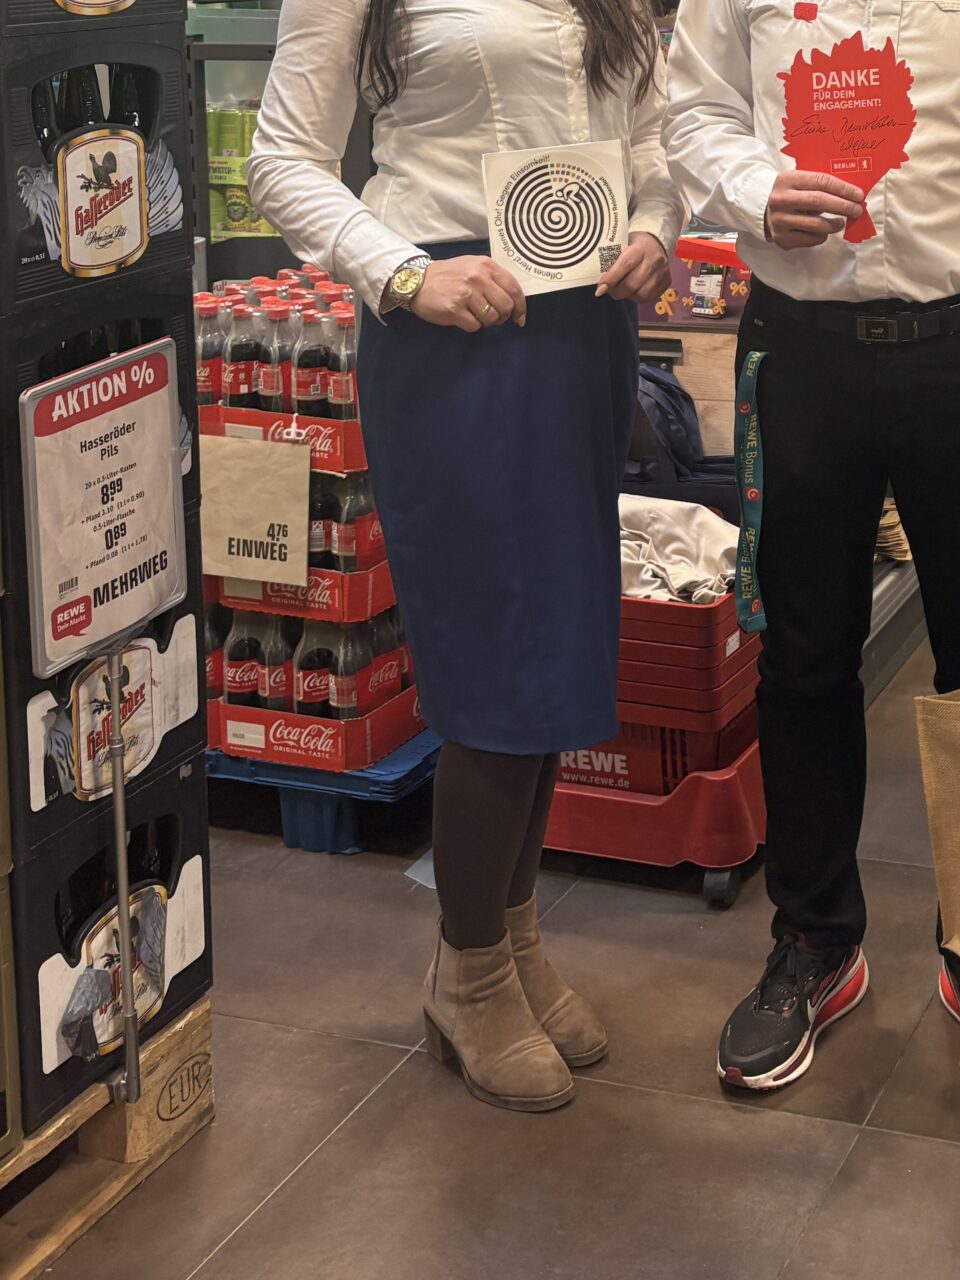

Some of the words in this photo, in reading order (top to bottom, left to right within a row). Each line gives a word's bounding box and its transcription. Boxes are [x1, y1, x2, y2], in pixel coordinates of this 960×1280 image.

[812, 68, 881, 90] DANKE
[813, 90, 832, 101] FÜR
[833, 89, 856, 100] DEIN
[814, 98, 882, 112] ENGAGEMENT!
[833, 162, 856, 170] BERLIN
[496, 180, 513, 207] Gegen
[510, 154, 551, 180] Einsamkeit!
[52, 369, 128, 422] AKTION
[131, 360, 155, 390] %
[80, 421, 136, 454] Hasseröder
[746, 414, 758, 449] REWE
[100, 443, 120, 461] Pils
[744, 452, 758, 484] Bonus
[86, 510, 101, 524] Pfand
[101, 505, 114, 518] 3.10
[227, 537, 288, 562] EINWEG
[90, 556, 106, 569] Pfand
[92, 550, 168, 608] MEHRWEG
[741, 566, 753, 600] REWE
[56, 602, 86, 624] REWE
[57, 622, 69, 633] Dein
[70, 614, 86, 628] Markt
[269, 720, 336, 752] Coca-Cola
[273, 745, 306, 758] ORIGINAL
[308, 750, 330, 759] TASTE
[560, 748, 629, 776] REWE
[561, 770, 630, 790] www.rewe.de
[168, 1060, 201, 1114] EUR
